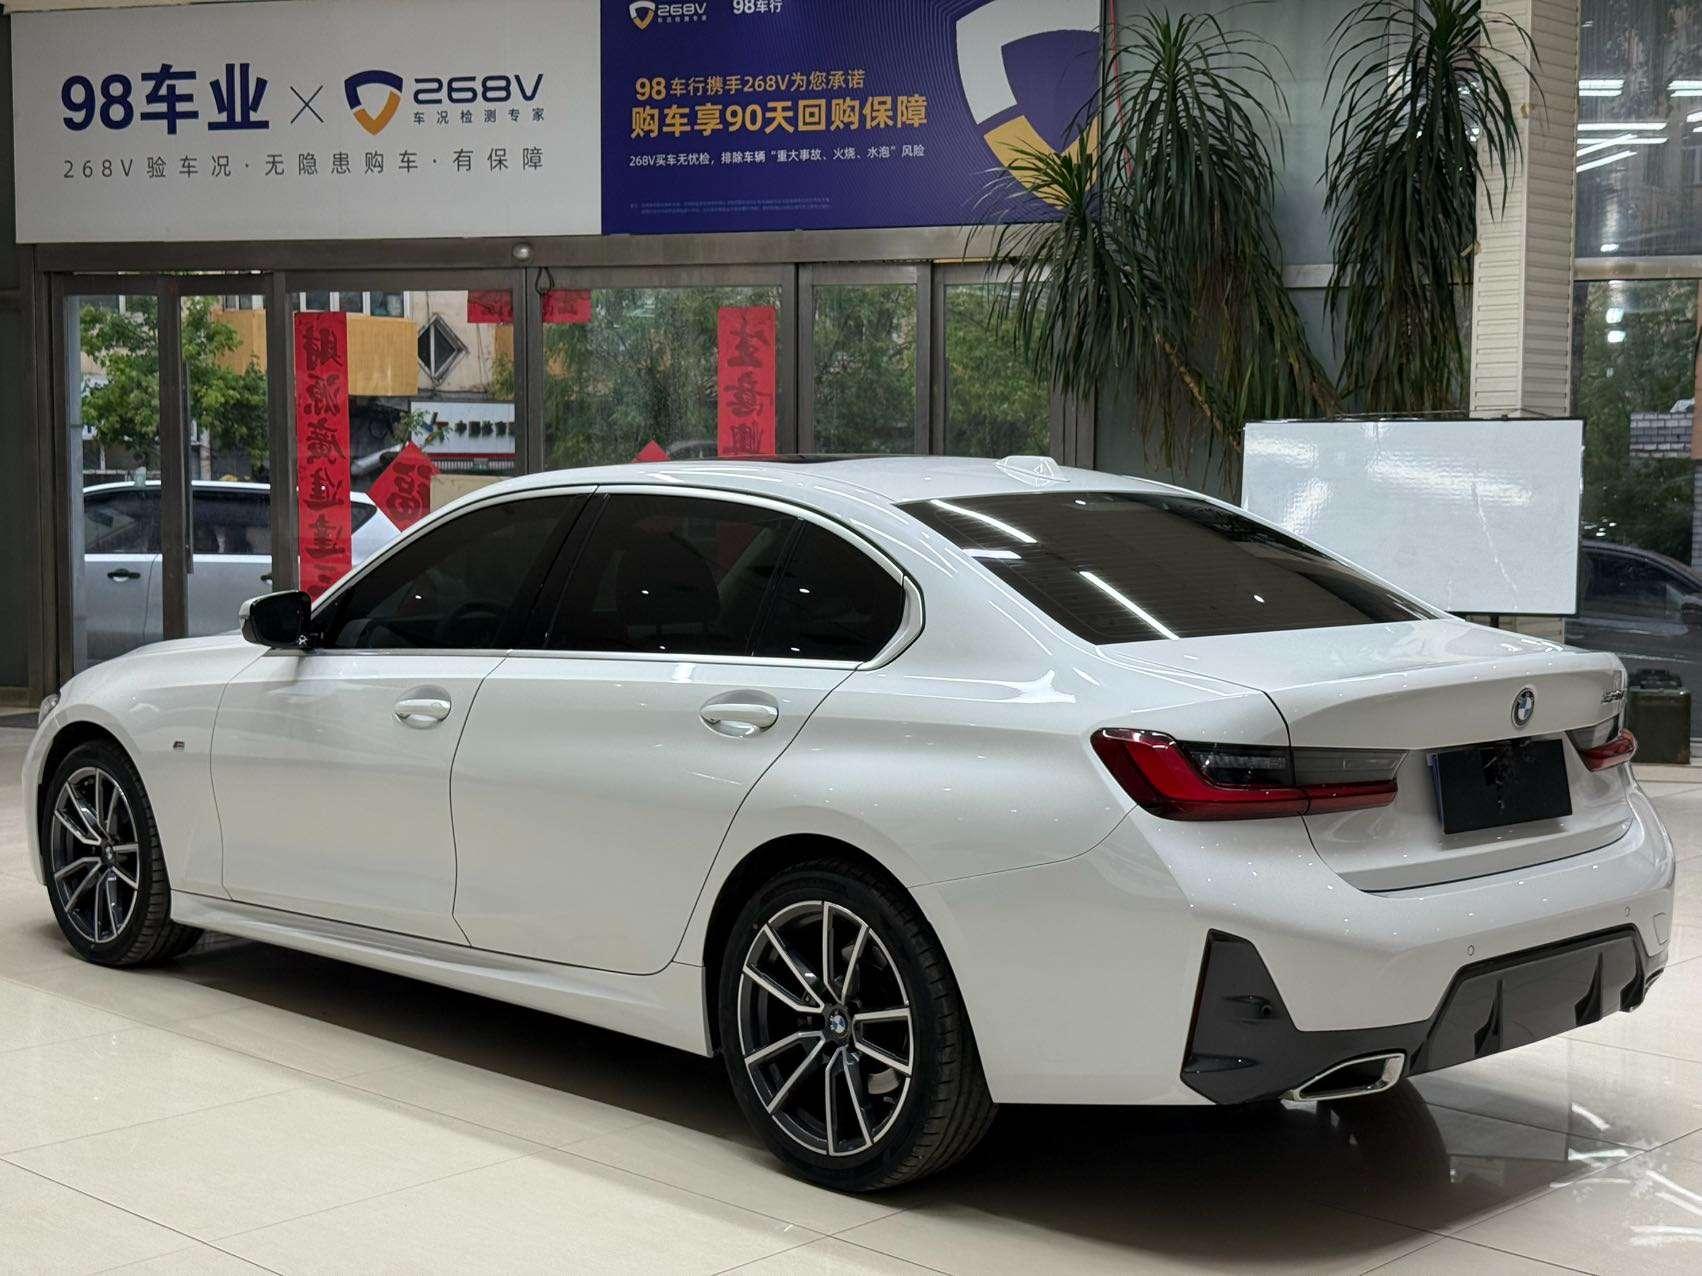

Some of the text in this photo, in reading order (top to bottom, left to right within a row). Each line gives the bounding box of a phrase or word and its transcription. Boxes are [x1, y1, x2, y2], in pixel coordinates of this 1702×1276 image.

[658, 3, 706, 16] 268V
[733, 0, 783, 15] 98车行
[61, 63, 269, 135] 98车业
[413, 73, 544, 104] 268V
[412, 108, 546, 125] 车况检测专家
[630, 94, 928, 139] 购车享90天回购保障
